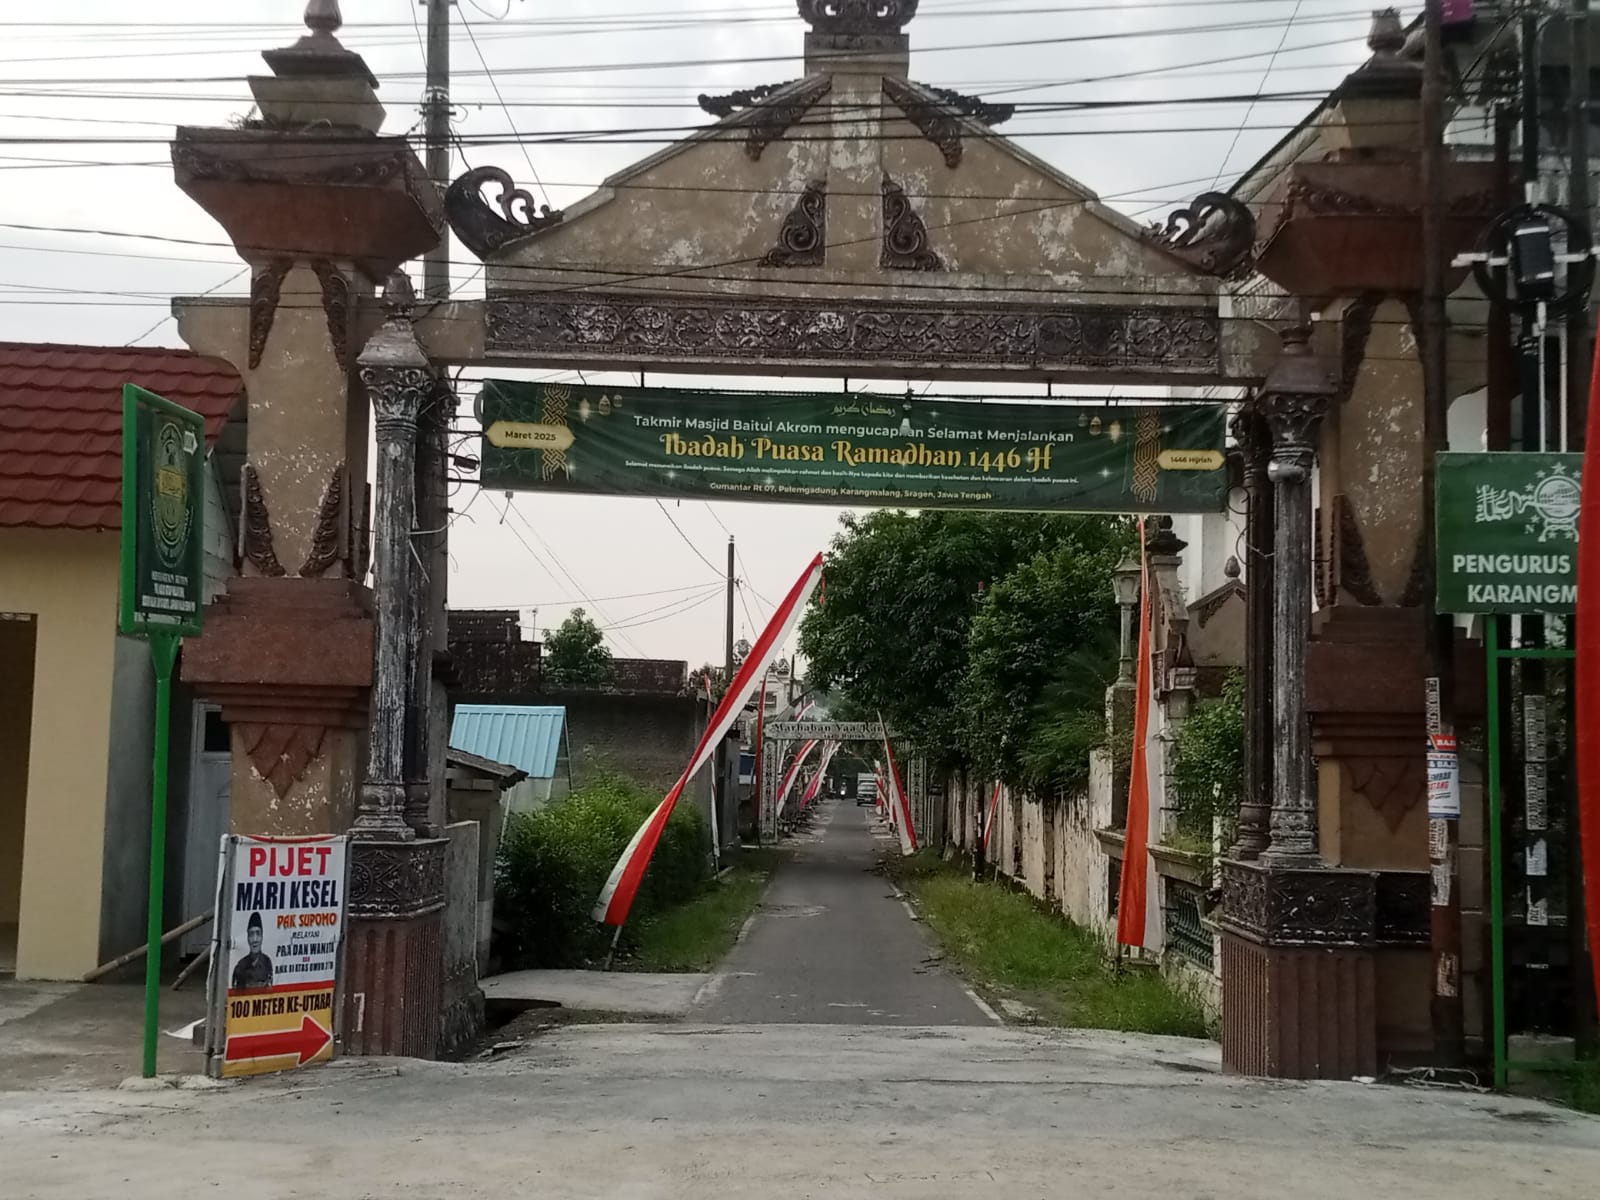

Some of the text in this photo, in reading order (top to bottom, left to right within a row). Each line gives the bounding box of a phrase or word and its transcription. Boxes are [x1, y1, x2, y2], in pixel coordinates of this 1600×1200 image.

[505, 431, 556, 441] Maret 2025
[634, 416, 1074, 443] Takmir Masjid Baitul Akrom mengucapan Selamat Menjalankan
[659, 433, 1055, 473] Ibadah Puasa Ramadhan 1446 H
[840, 488, 903, 499] Karangmalang,
[937, 491, 959, 499] Jawa
[960, 491, 992, 500] Tengah
[1453, 554, 1571, 574] PENGURUS
[1467, 584, 1578, 603] KARANGM
[249, 847, 332, 877] PIJET
[236, 880, 338, 911] MARI KESEL
[277, 912, 337, 929] PAK SUPOMO
[292, 943, 308, 956] DAN
[310, 942, 334, 955] WANITA
[231, 993, 331, 1019] 100 METER KE-UTARA
